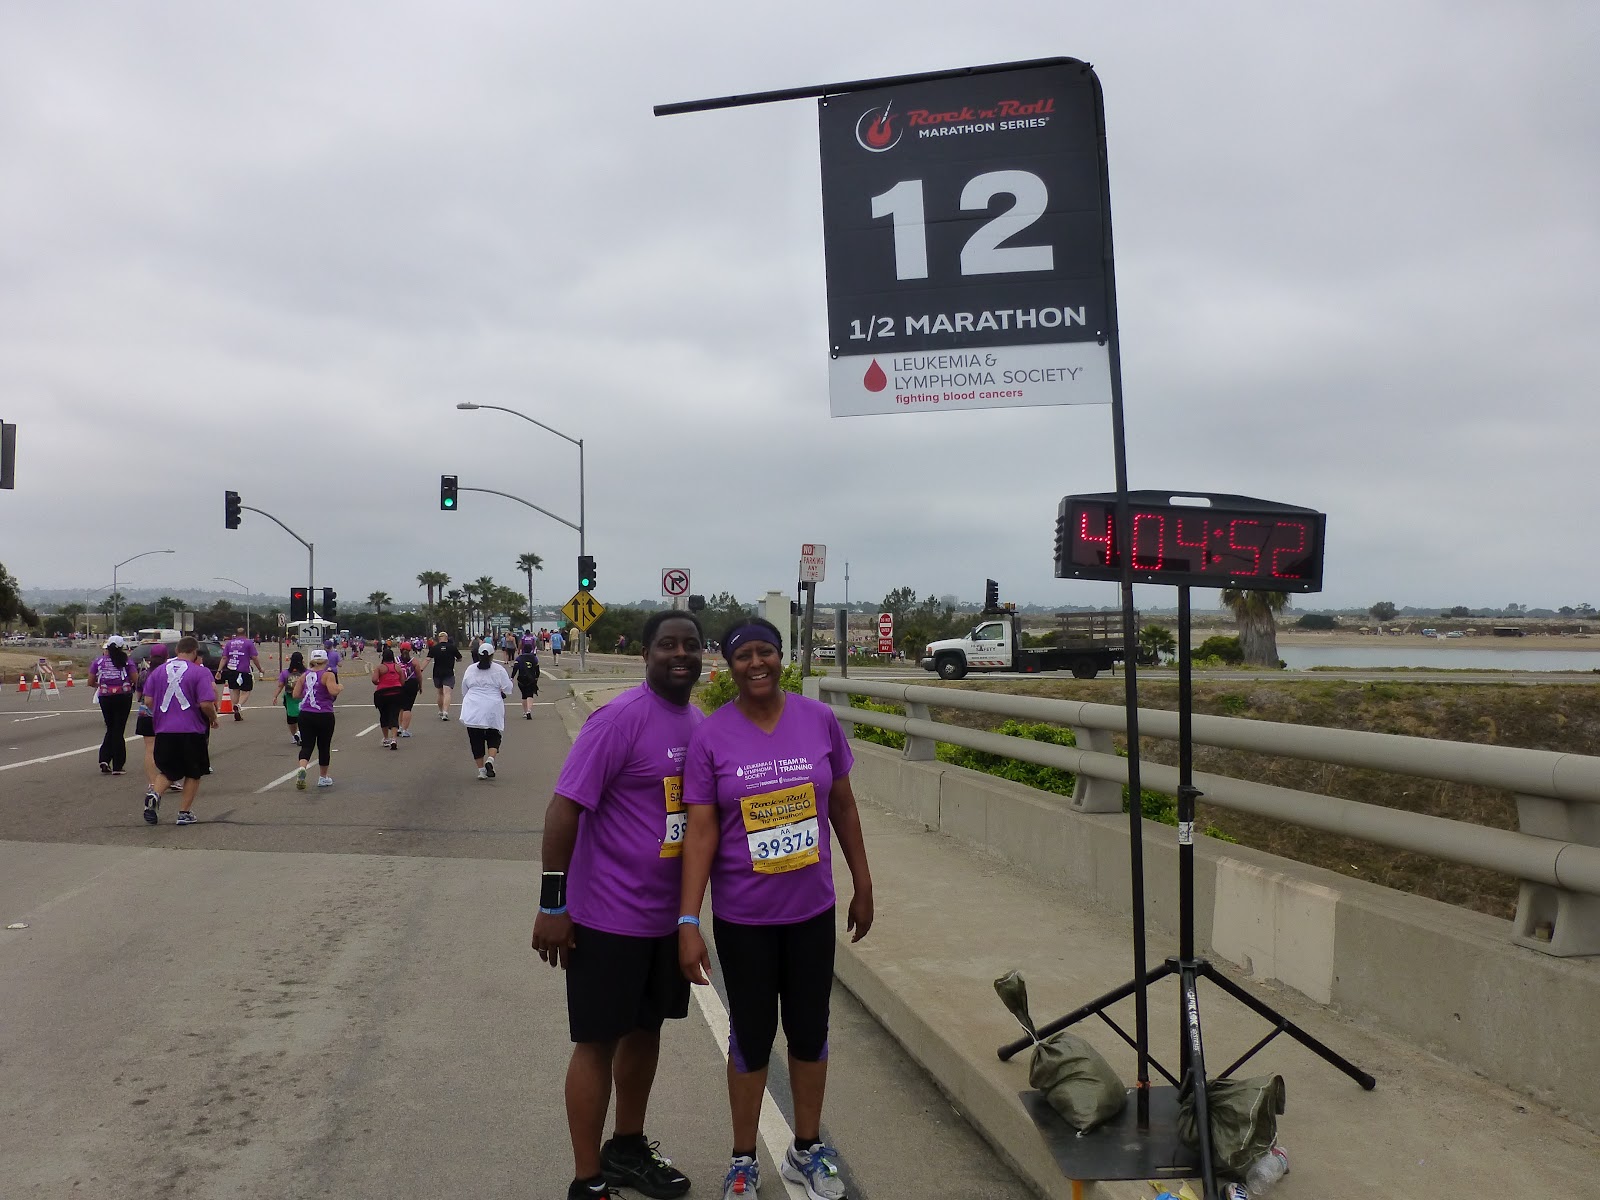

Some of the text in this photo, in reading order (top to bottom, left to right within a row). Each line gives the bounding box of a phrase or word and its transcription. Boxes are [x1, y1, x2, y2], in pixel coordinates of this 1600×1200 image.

[907, 107, 977, 127] Rock
[998, 98, 1055, 117] Roll
[919, 122, 995, 139] MARATHON
[871, 169, 1054, 281] 12
[849, 306, 1086, 342] 1/2 MARATHON
[893, 353, 998, 372] LEUKEMIA &
[894, 372, 996, 390] LYMPHOMA
[895, 389, 1024, 405] fighting blood cancers
[803, 545, 813, 555] NO
[778, 758, 799, 766] TEAM
[779, 763, 813, 773] TRAINING
[750, 800, 777, 809] Rock
[785, 792, 807, 803] Roll
[749, 799, 811, 820] SAN DIEGO
[780, 828, 791, 836] AA
[757, 829, 814, 859] 39376
